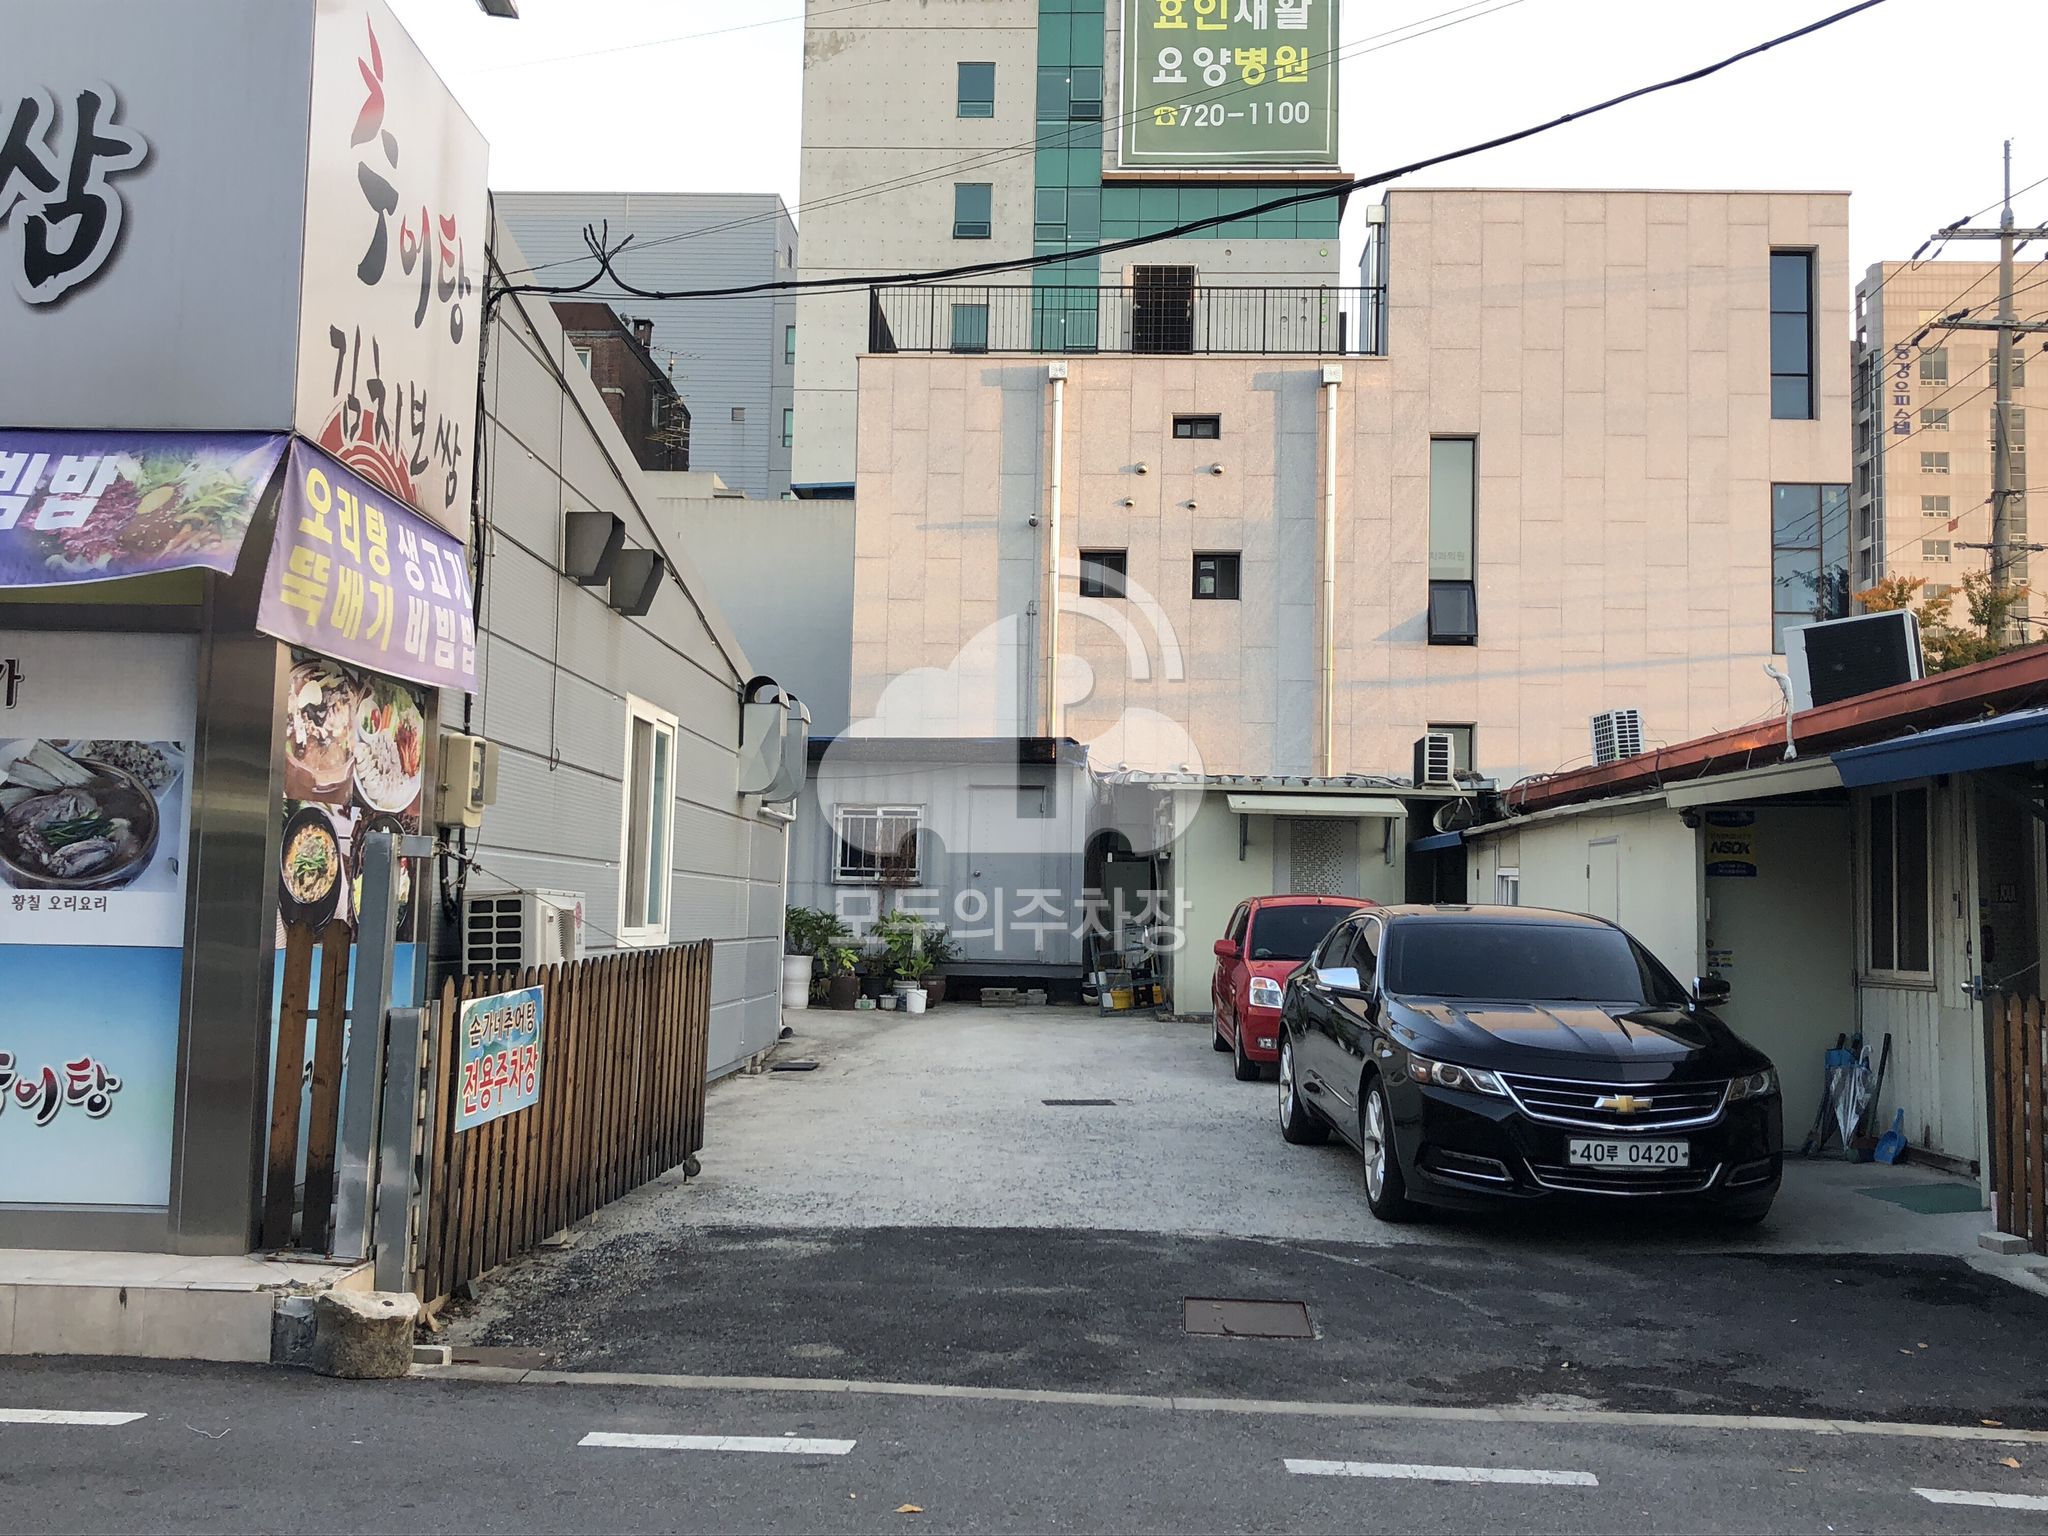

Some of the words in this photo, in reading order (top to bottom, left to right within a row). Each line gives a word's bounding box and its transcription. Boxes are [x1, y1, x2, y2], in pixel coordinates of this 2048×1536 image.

[1152, 45, 1308, 87] 요양병원
[1179, 101, 1310, 127] 720-1100
[350, 12, 471, 345] 추어탕
[330, 323, 462, 508] 김치보쌈
[298, 467, 391, 577] 오리탕
[398, 524, 473, 610] 생고기
[280, 545, 394, 652] 뚝배기
[404, 595, 475, 676] 비빔밥
[11, 894, 41, 911] 황칠
[48, 895, 107, 912] 오리요리
[468, 1002, 536, 1047] 손가네추어탕
[462, 1044, 540, 1116] 전용주차장
[1580, 1143, 1619, 1162] 40루
[1628, 1144, 1679, 1164] 0420
